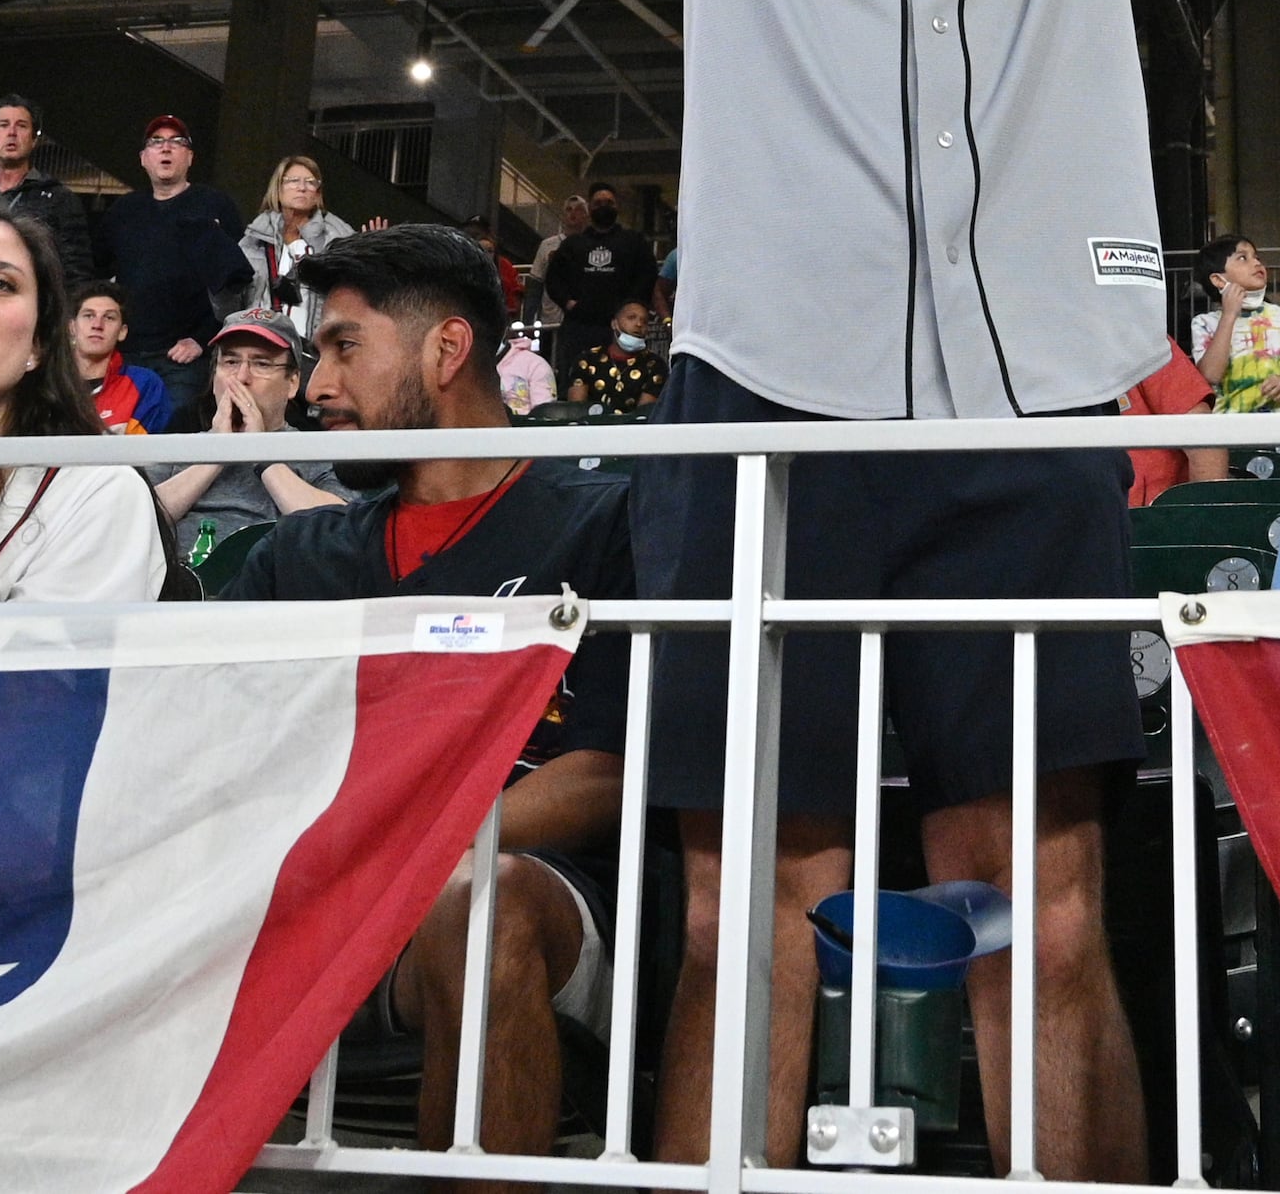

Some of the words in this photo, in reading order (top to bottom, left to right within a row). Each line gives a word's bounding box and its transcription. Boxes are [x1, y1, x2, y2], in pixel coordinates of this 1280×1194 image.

[1119, 250, 1156, 265] Majestic
[1227, 573, 1239, 591] 8
[1131, 651, 1144, 676] 8
